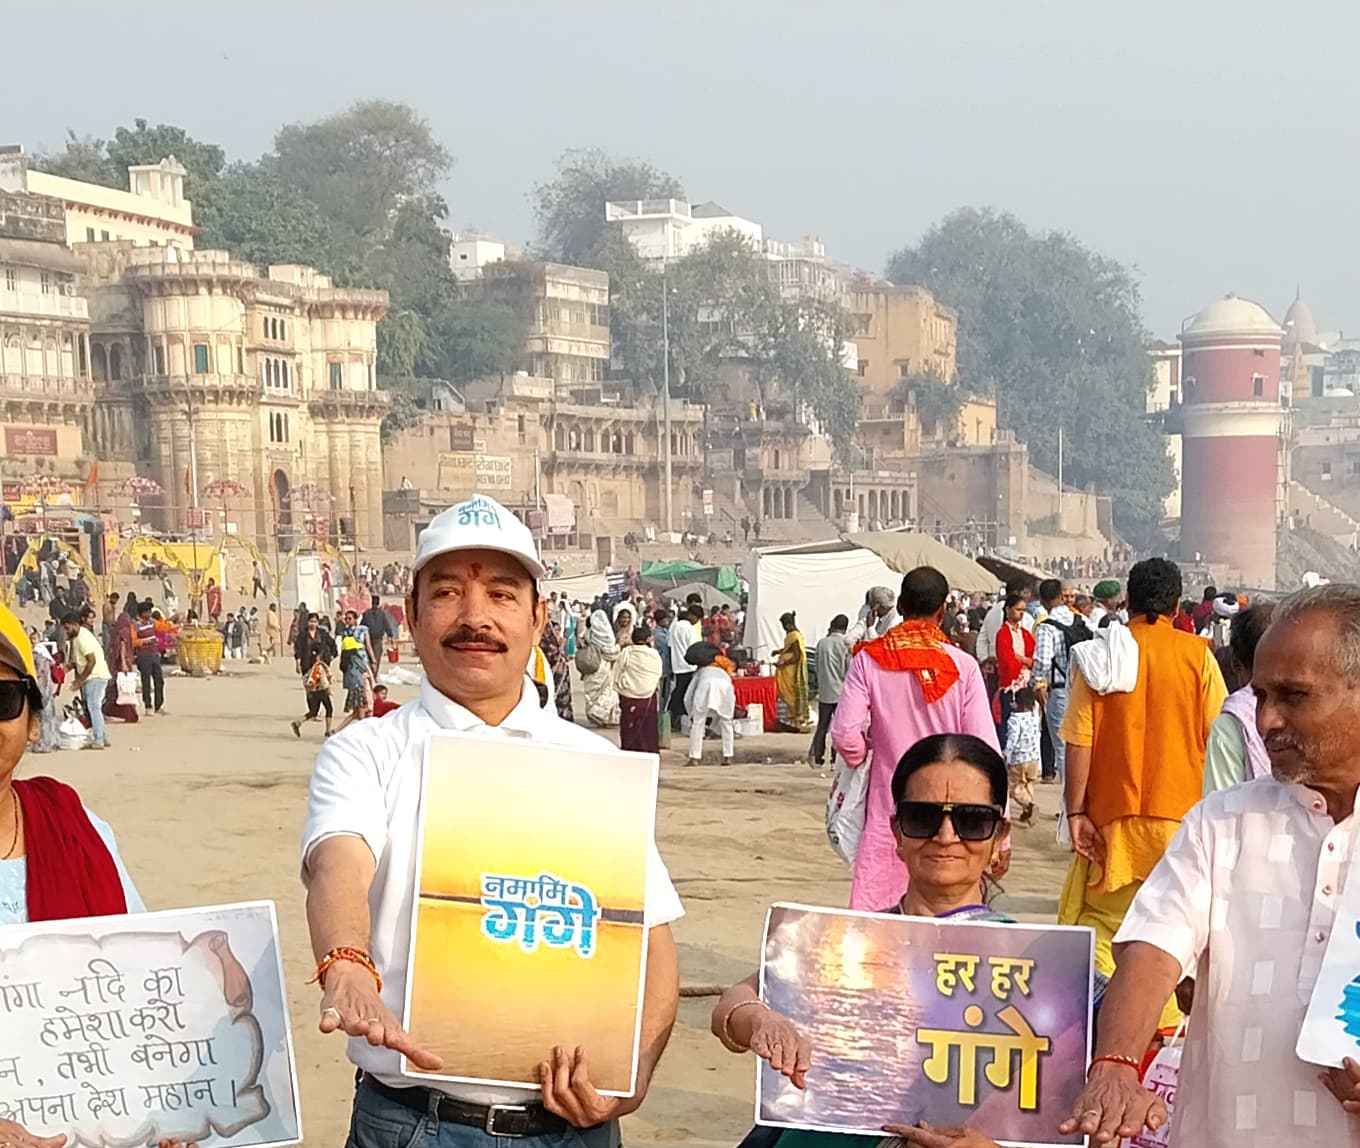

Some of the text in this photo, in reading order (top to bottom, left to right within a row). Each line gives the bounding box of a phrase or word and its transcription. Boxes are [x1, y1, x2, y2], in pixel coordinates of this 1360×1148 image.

[485, 875, 568, 905] नमामि
[484, 886, 597, 954] गंगे
[143, 966, 185, 1003] का
[933, 953, 1035, 1000] हर हर
[40, 997, 186, 1047] हमेशा करो
[57, 1042, 115, 1080] तभी
[130, 1034, 218, 1071] बनेगा
[916, 1004, 1052, 1111] गंगे
[86, 1081, 130, 1121] देश
